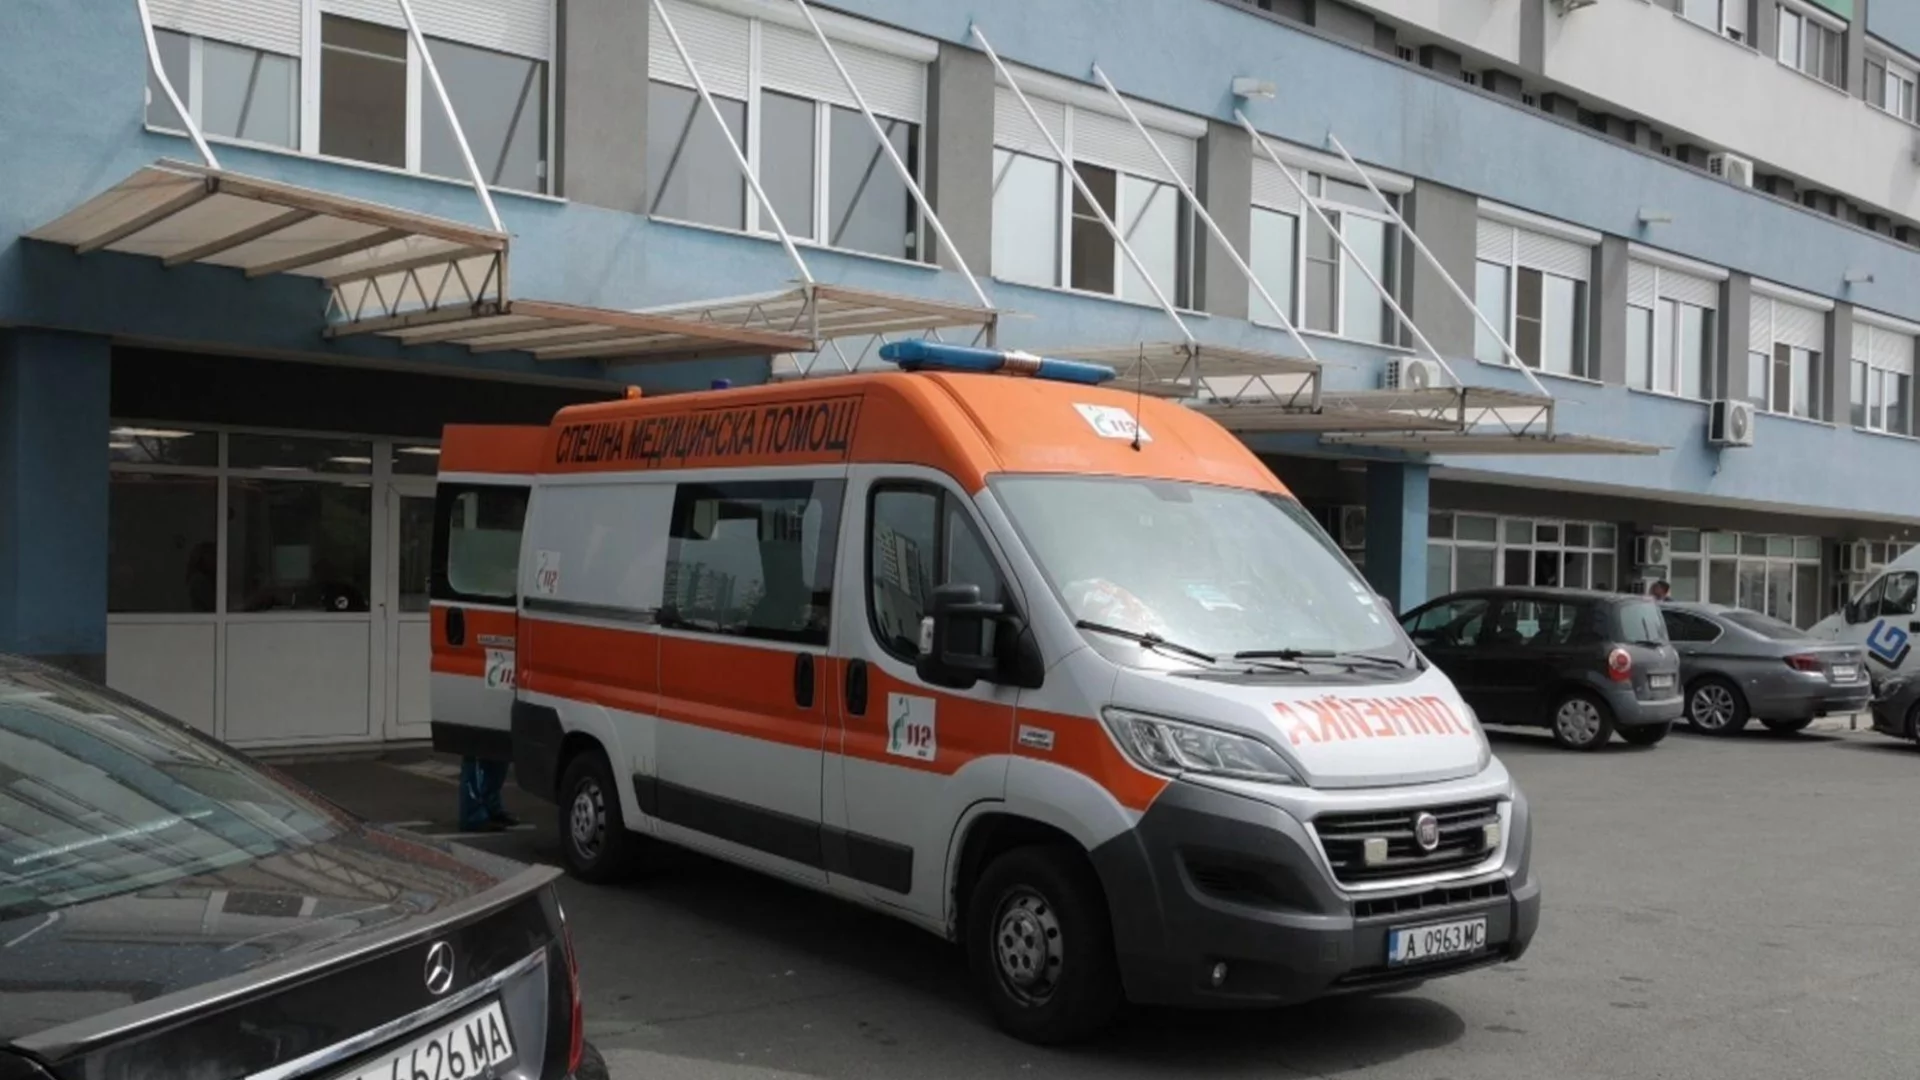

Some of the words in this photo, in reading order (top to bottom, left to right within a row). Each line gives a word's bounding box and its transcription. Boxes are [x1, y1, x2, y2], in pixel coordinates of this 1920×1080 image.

[555, 422, 624, 465] СПЕШНА
[625, 409, 757, 468] МЕДИЦИНСКА
[760, 400, 854, 460] ПОМОЩ
[543, 570, 557, 589] 112
[907, 722, 931, 748] 112
